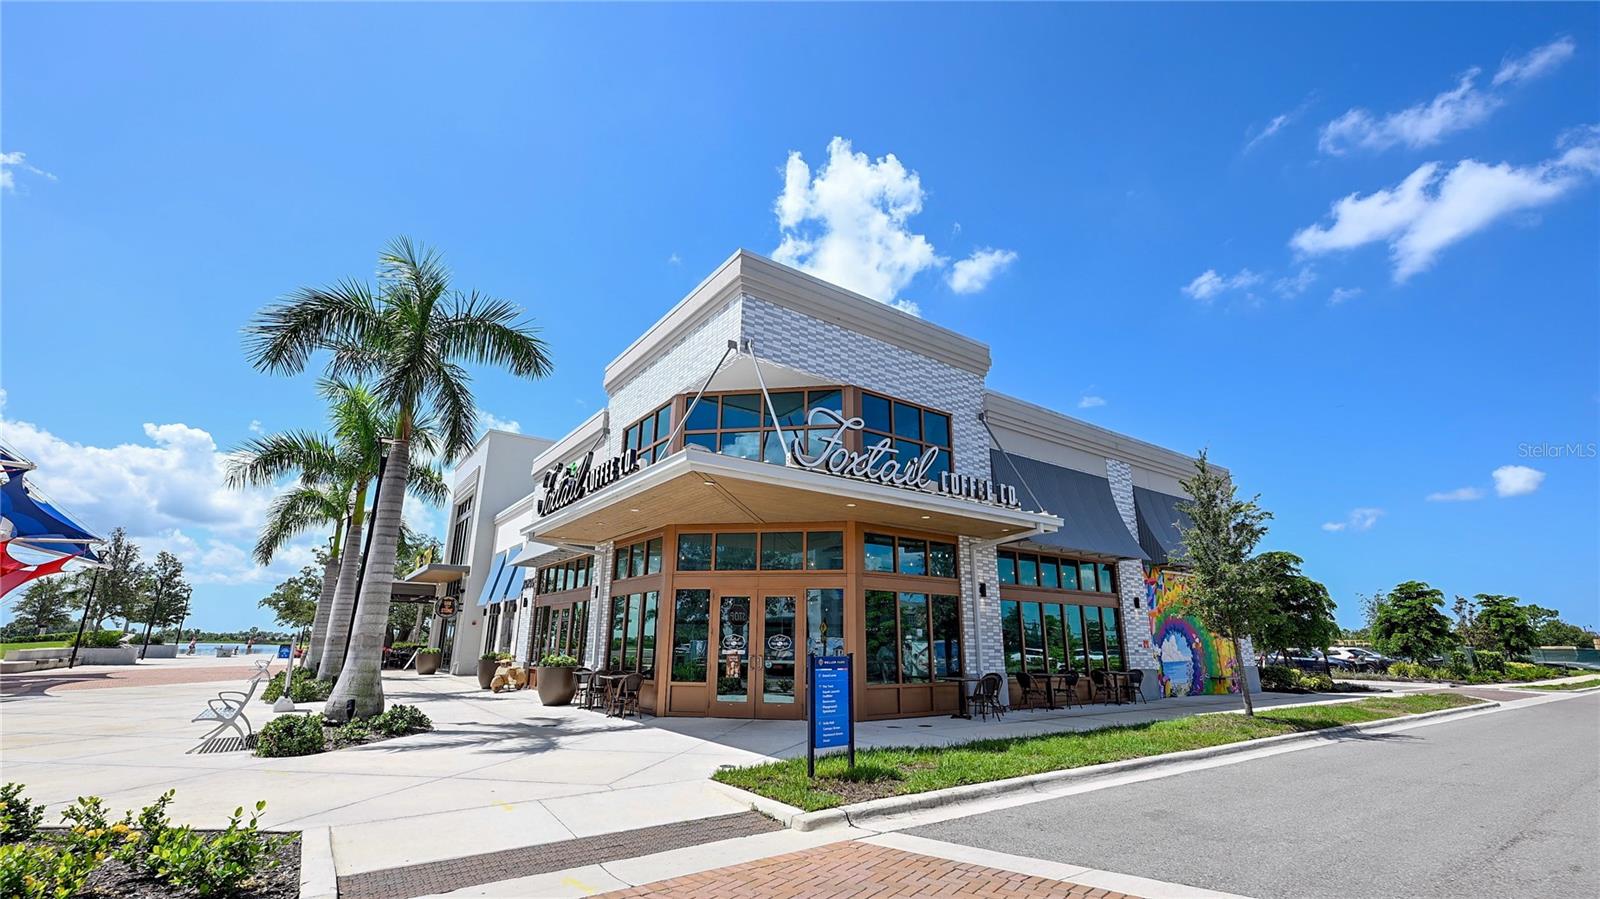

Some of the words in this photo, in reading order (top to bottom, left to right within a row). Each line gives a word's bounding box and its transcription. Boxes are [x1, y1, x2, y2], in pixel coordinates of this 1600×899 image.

[791, 406, 940, 488] Foxtail
[939, 470, 994, 502] COFFEE
[997, 482, 1022, 508] CO.
